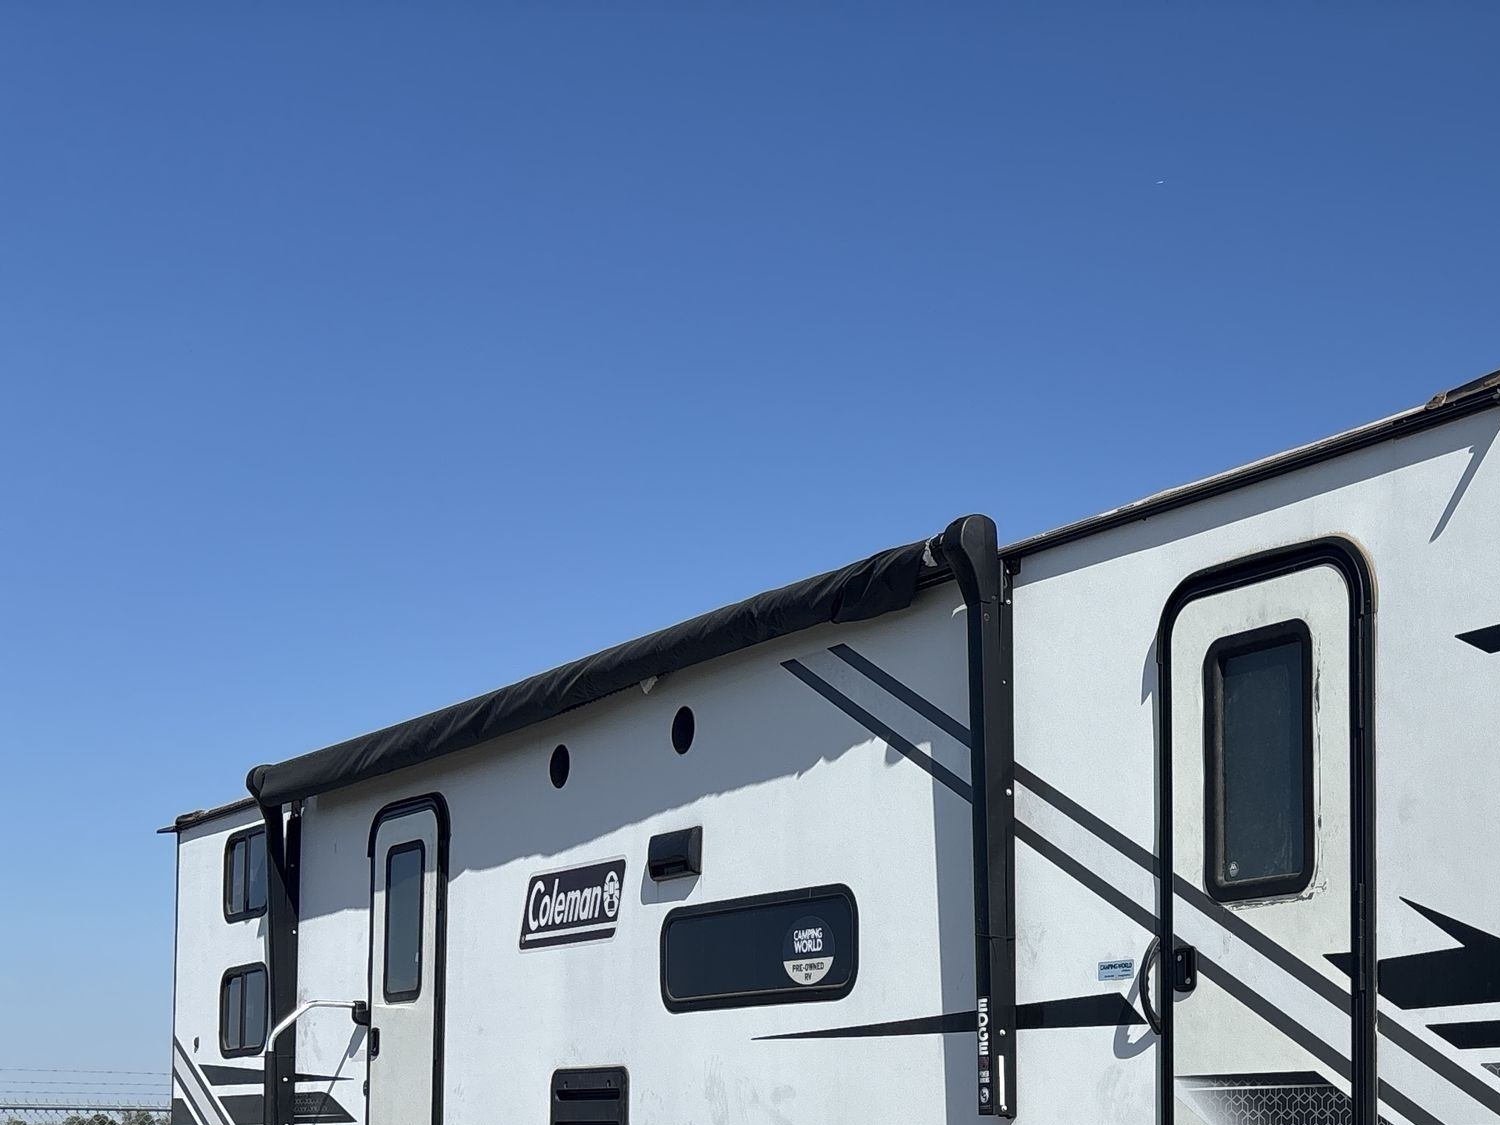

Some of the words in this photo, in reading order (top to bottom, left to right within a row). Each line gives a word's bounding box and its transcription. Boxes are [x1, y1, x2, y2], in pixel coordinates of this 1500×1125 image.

[528, 878, 602, 931] Coleman
[793, 927, 823, 941] CAMPING
[793, 938, 823, 953] WORLD
[792, 961, 825, 973] PRE-OWNED
[804, 972, 812, 981] RV
[978, 998, 989, 1056] EDGE
